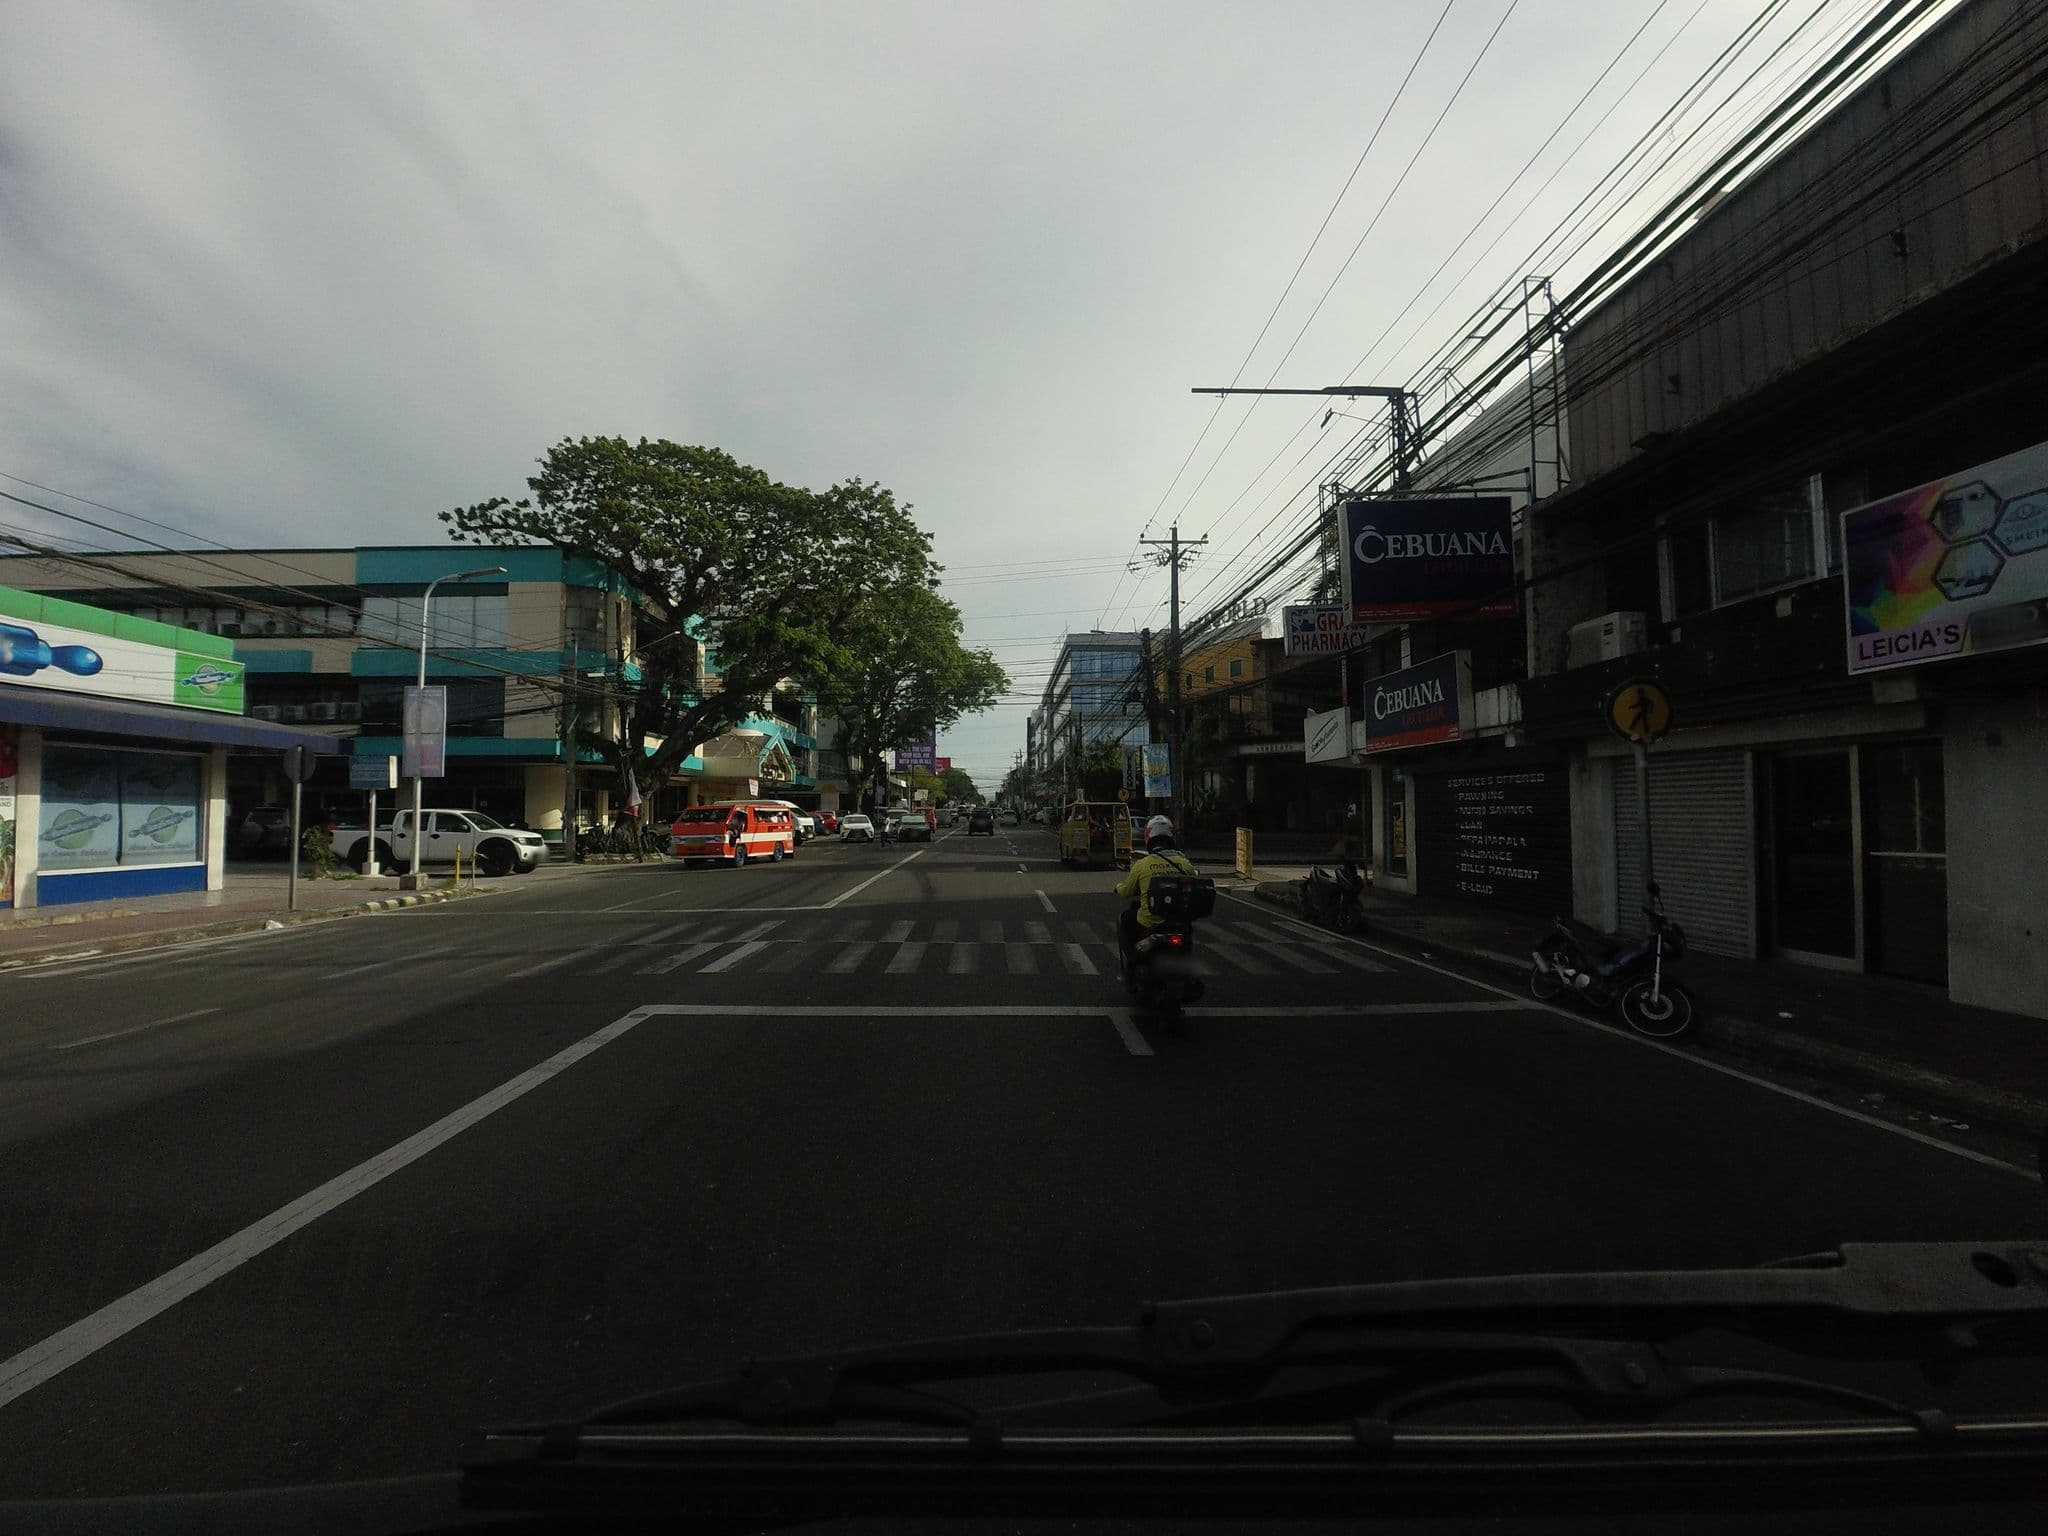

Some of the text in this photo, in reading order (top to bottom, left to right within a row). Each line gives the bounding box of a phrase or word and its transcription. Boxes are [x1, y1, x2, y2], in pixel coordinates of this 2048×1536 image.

[1354, 525, 1509, 564] CEBUANA
[1291, 632, 1367, 652] PHARMACY
[1859, 624, 1959, 660] LEICIA'S
[1374, 678, 1445, 720] CEBUANA
[1448, 773, 1544, 787] SERVICES OFFERED
[1488, 865, 1540, 880] PAYMENT
